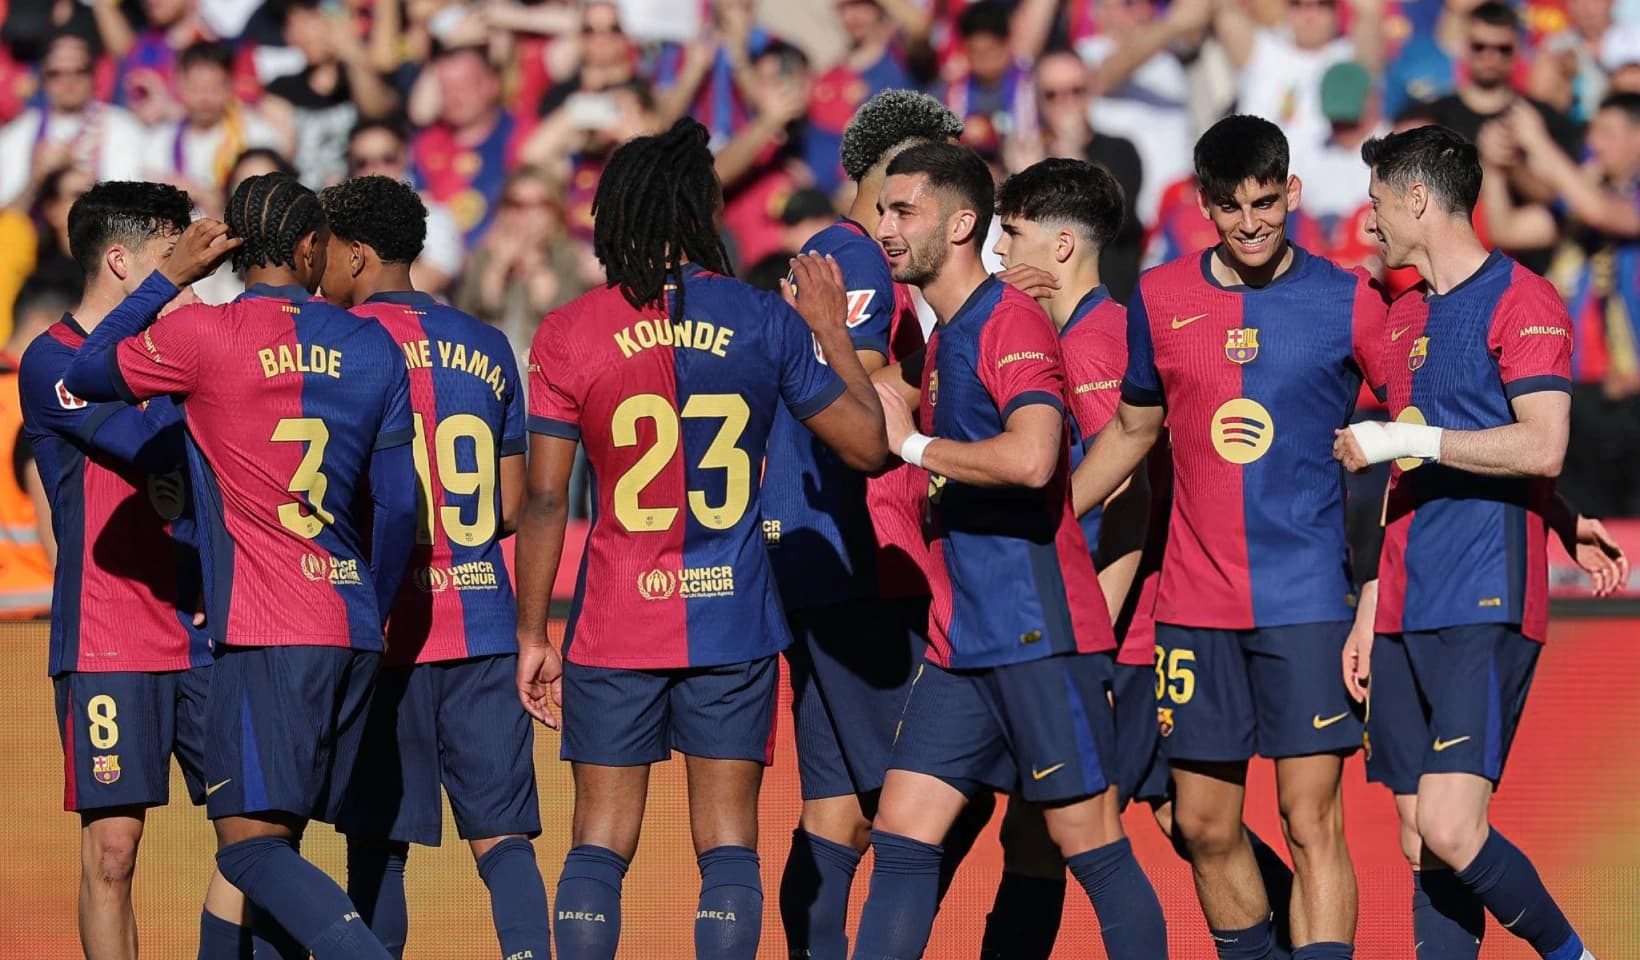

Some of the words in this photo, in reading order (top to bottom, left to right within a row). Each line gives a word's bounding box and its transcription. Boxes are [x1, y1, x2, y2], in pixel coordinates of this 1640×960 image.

[613, 319, 735, 359] KOUNDE
[1519, 326, 1567, 338] AMBILIGHT
[258, 343, 342, 379] BALDE
[437, 340, 506, 401] YAMAL
[270, 417, 335, 539] 3
[611, 393, 751, 532] 23
[447, 561, 494, 576] UNHCR
[452, 573, 497, 586] ACNUR
[678, 566, 733, 581] UNHCR
[679, 578, 735, 594] ACNUR
[87, 694, 120, 750] 8
